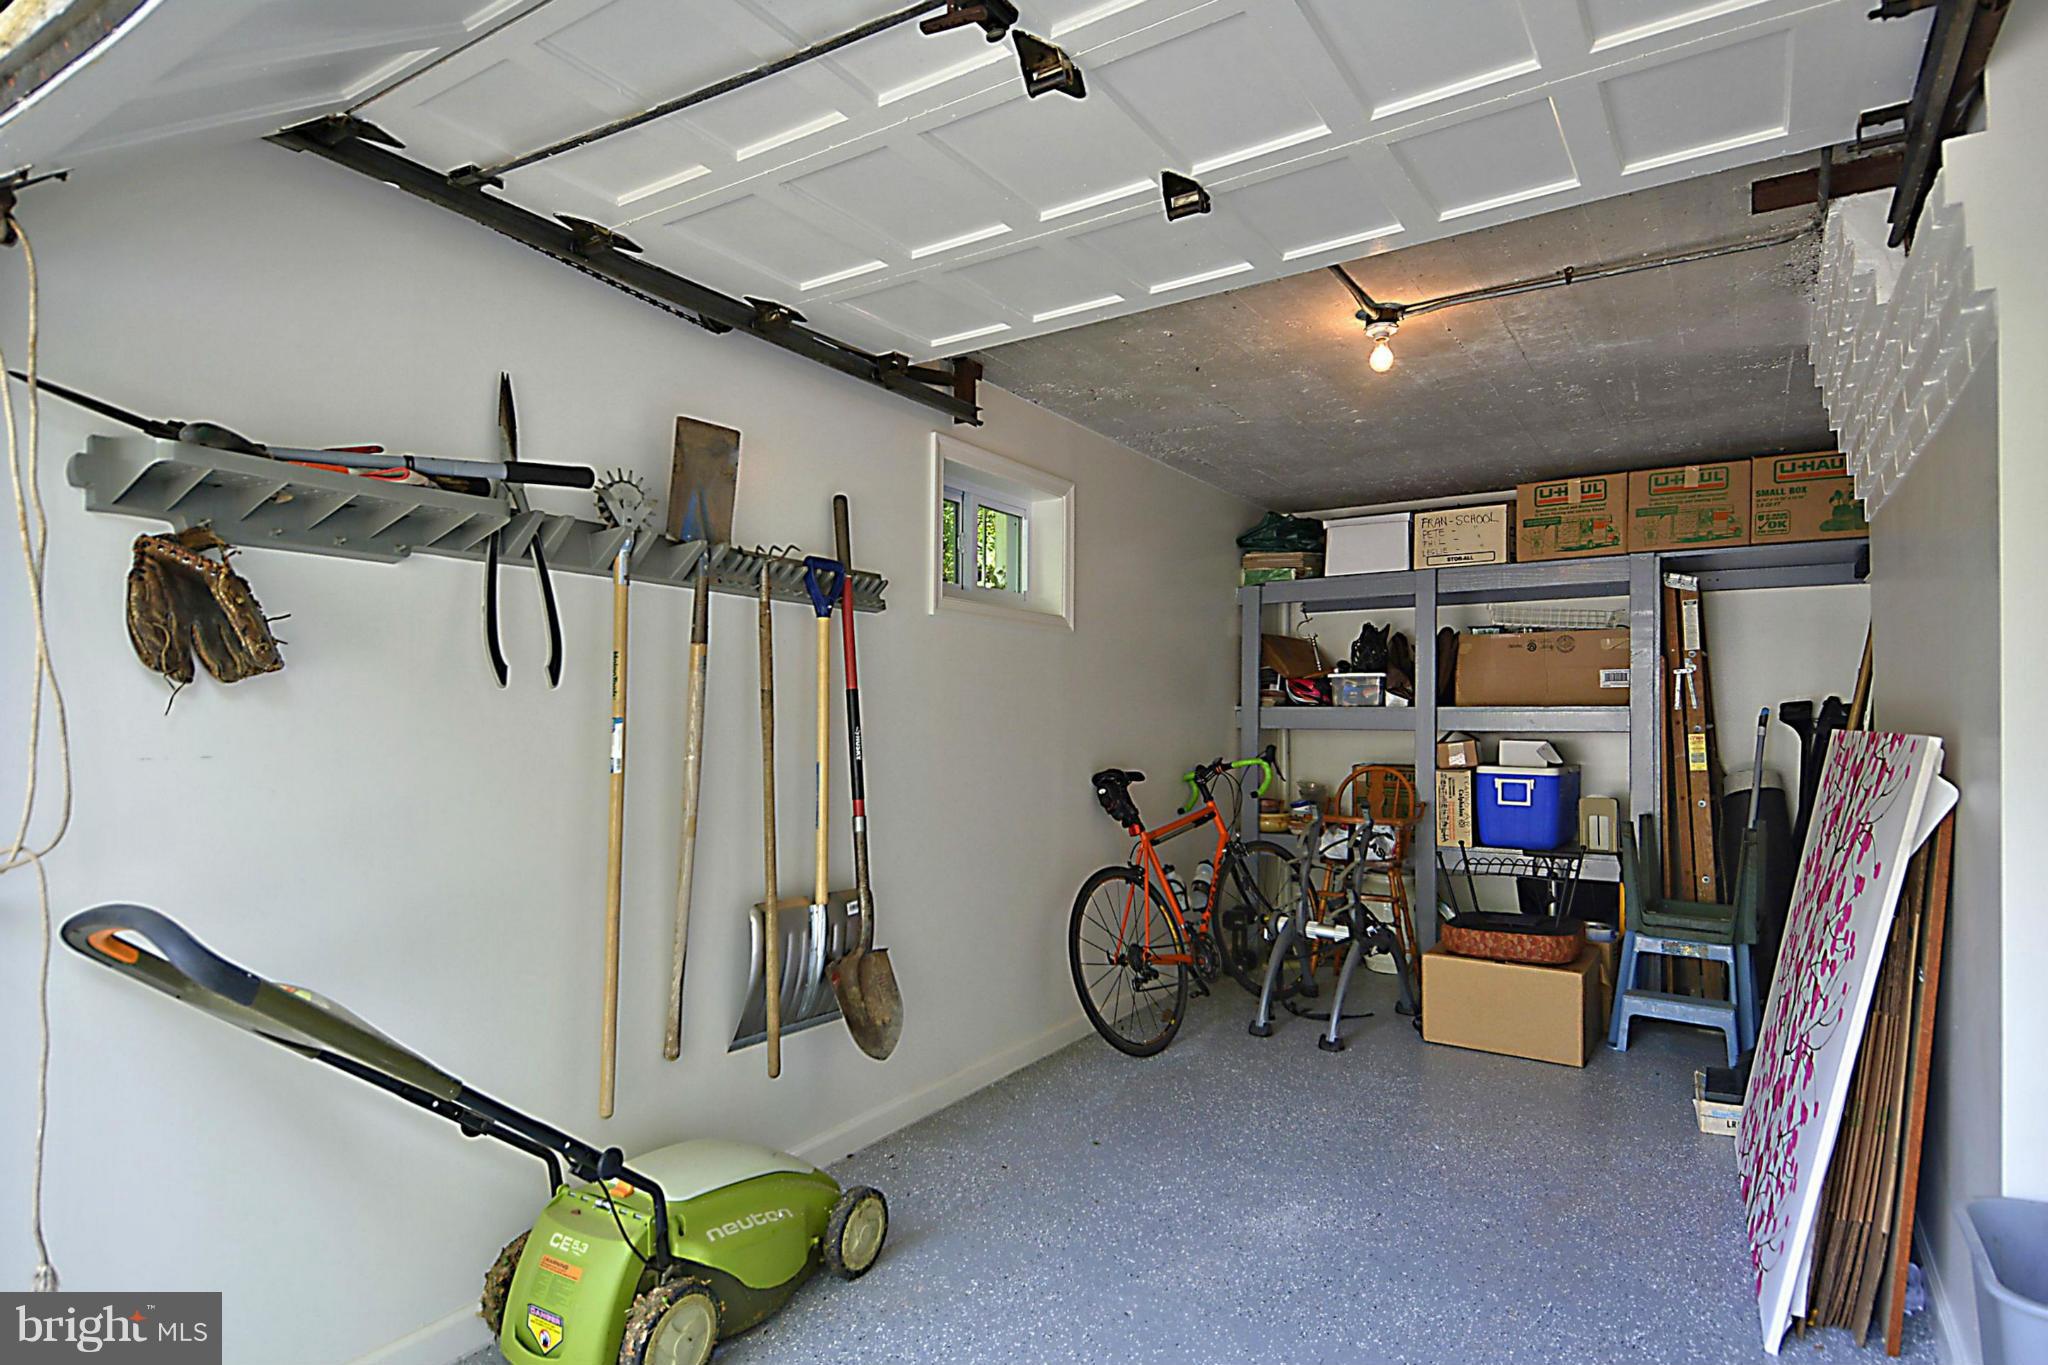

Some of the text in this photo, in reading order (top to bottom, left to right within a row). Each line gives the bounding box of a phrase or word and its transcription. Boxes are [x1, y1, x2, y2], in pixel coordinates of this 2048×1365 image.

[1780, 458, 1844, 474] U-HAU
[1654, 471, 1725, 487] U-HUL
[1539, 483, 1603, 499] U-HUL
[1756, 486, 1808, 497] SMALL BOX
[706, 1208, 793, 1242] neuton
